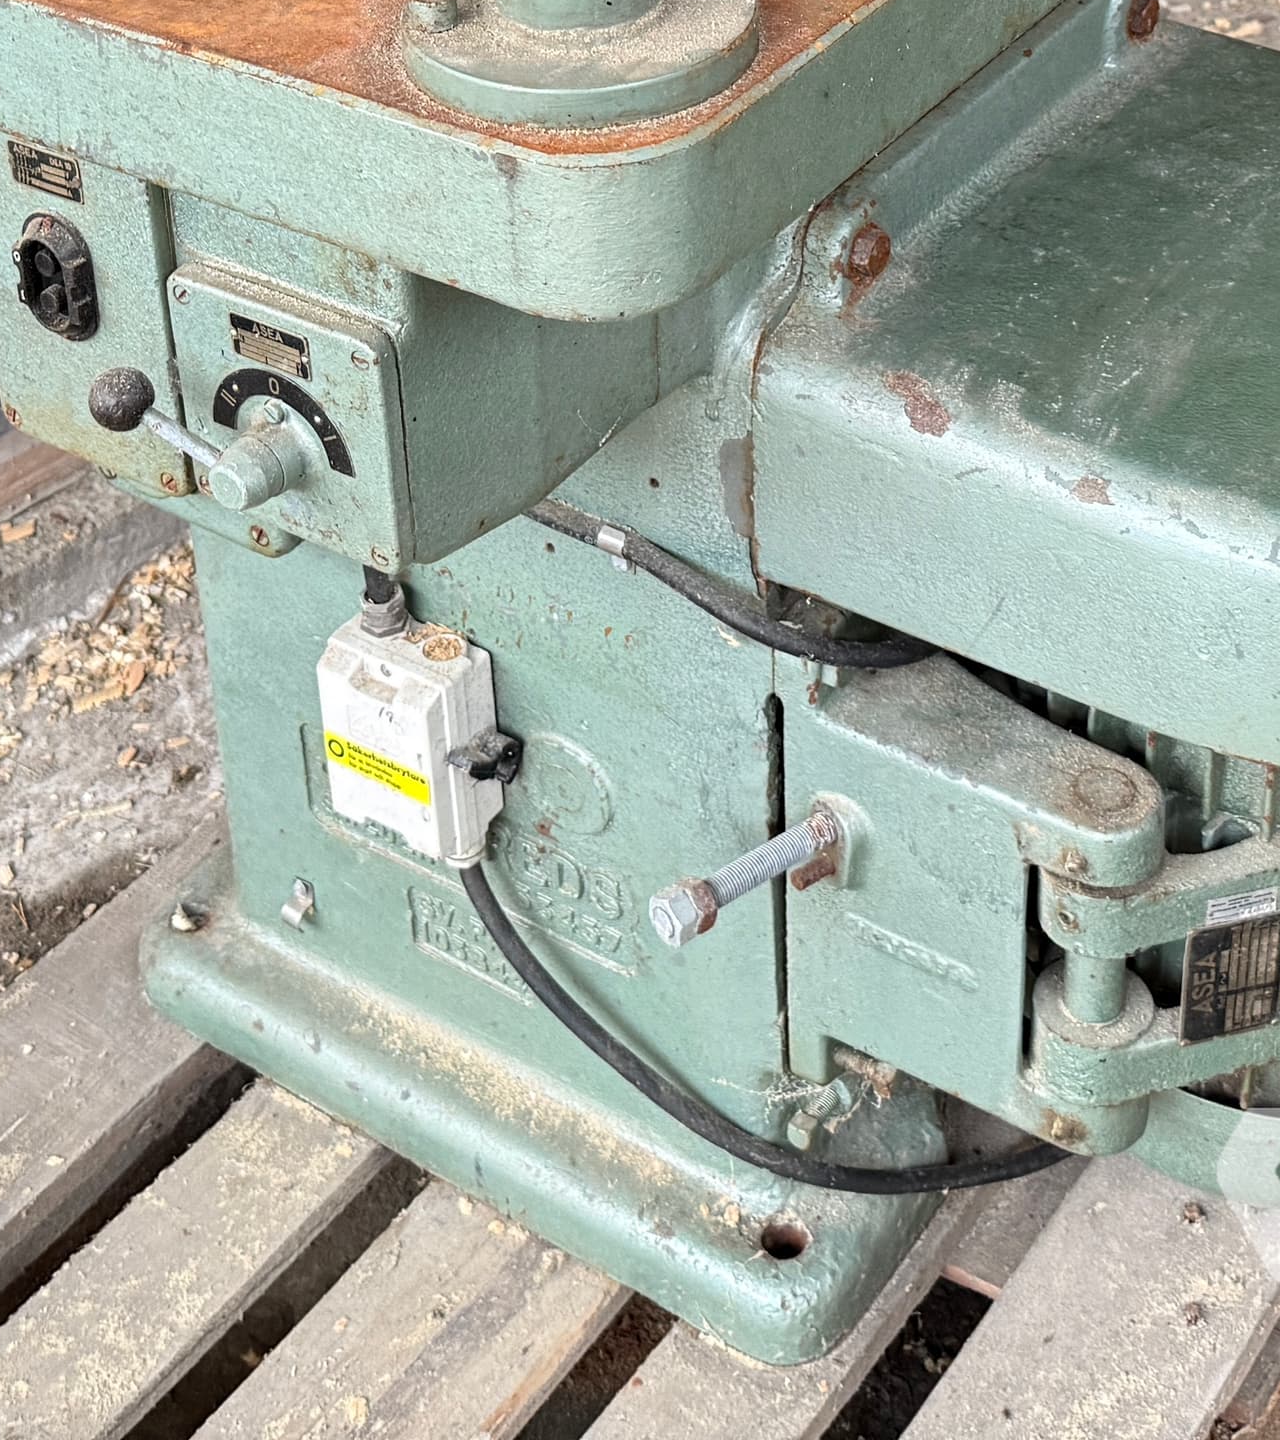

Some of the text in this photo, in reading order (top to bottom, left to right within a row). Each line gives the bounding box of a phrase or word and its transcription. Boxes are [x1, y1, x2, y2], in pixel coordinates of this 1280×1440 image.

[13, 143, 38, 160] ASEA
[252, 322, 284, 344] ASEA
[268, 377, 280, 395] 0
[1191, 951, 1217, 1014] ASEA
